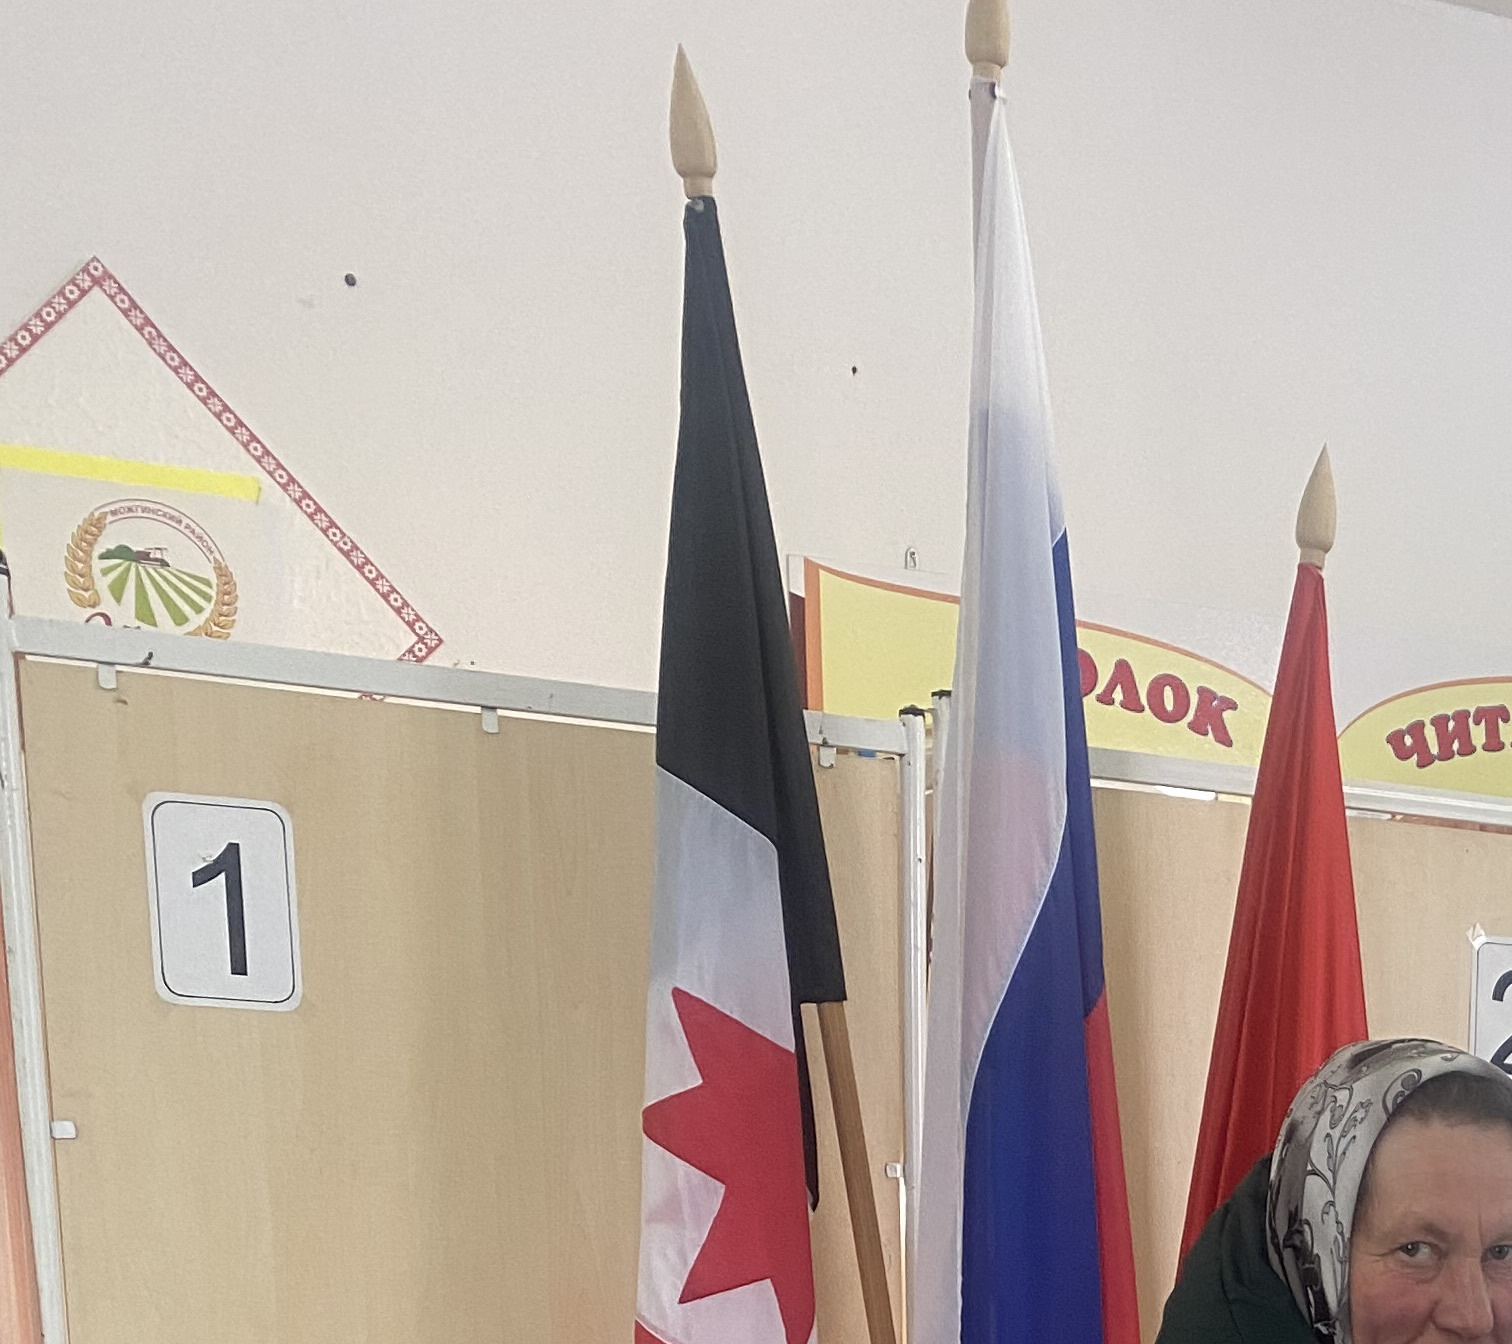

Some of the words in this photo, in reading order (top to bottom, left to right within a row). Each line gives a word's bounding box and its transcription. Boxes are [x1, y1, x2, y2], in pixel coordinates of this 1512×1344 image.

[109, 504, 184, 525] МОЖГИНСКИЙ
[183, 522, 215, 556] РАЙОН
[1077, 648, 1239, 748] ЛОК
[190, 841, 249, 977] 1
